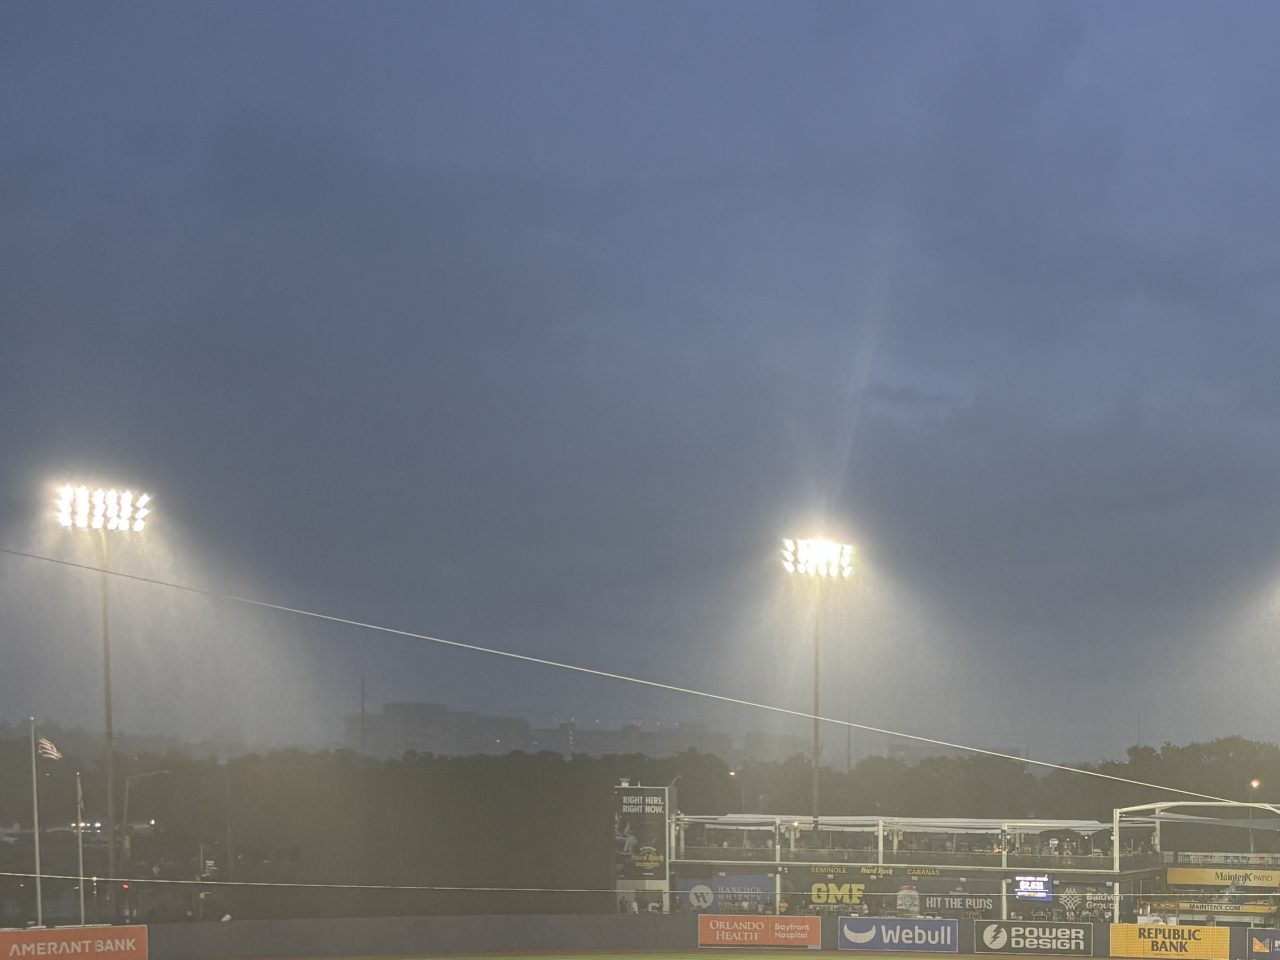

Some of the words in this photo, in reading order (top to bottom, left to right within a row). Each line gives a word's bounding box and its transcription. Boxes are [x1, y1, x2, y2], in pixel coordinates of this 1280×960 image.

[622, 796, 644, 804] RIGHT
[645, 797, 665, 805] HERE.
[622, 805, 643, 813] RIGHT
[811, 882, 866, 905] GMF
[926, 897, 938, 908] HIT
[944, 897, 963, 909] THE
[709, 919, 765, 930] ORLANDO
[774, 923, 810, 933] Bayfront
[716, 930, 759, 941] HEALTH
[774, 931, 808, 940] Hospital
[881, 925, 951, 945] Webull
[1138, 927, 1202, 941] REPUBLIC
[9, 940, 92, 957] AMERANT
[95, 938, 136, 952] BANK
[1151, 940, 1189, 953] BANK
